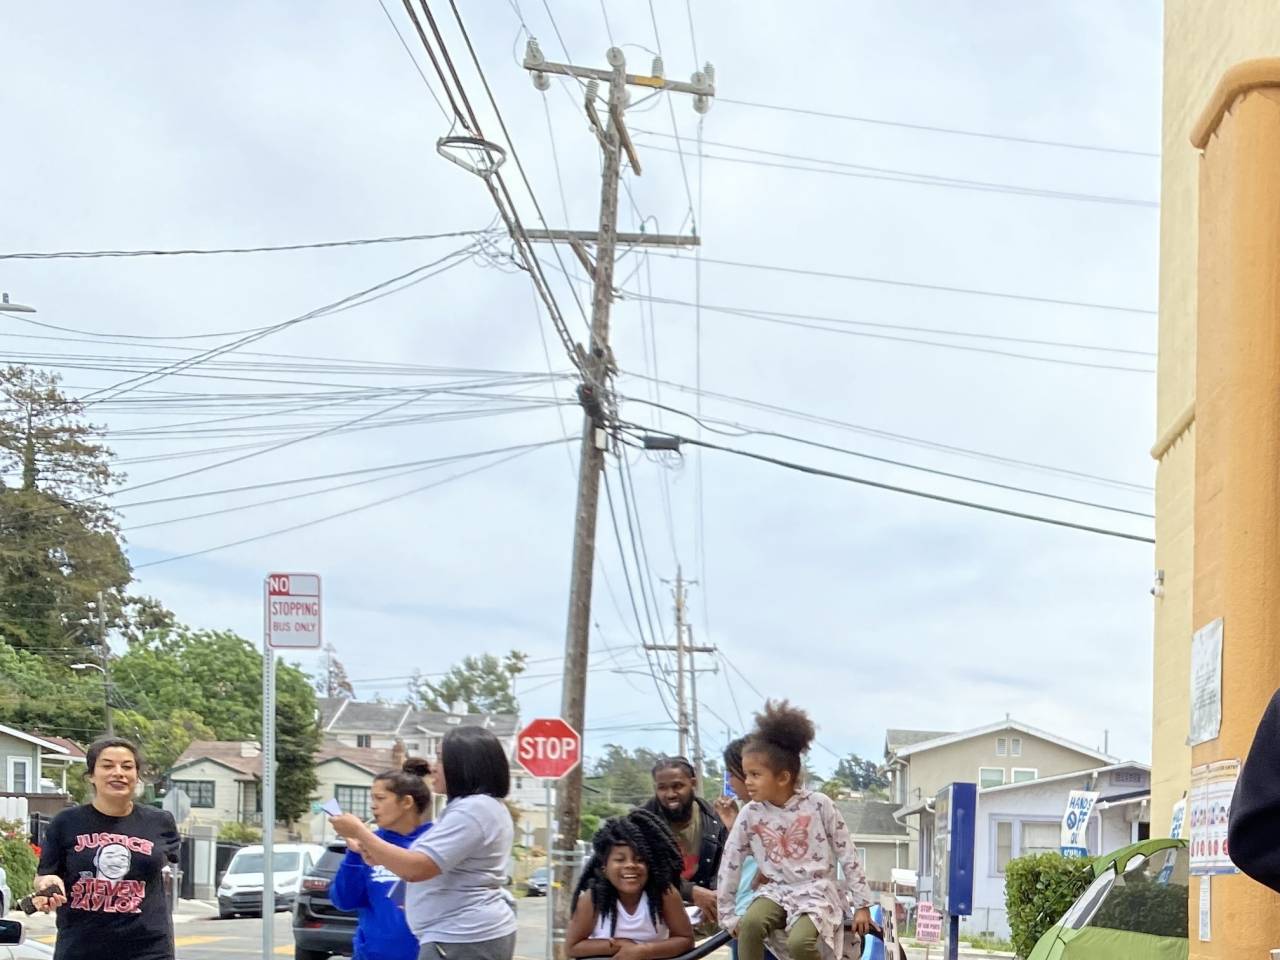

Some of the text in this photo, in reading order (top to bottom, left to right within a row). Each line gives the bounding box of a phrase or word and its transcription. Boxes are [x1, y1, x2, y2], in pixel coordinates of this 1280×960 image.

[269, 576, 289, 592] NO
[272, 601, 319, 616] STOPPING
[272, 621, 316, 632] BUS ONLY
[520, 736, 576, 760] STOP
[74, 832, 154, 856] JUSTICE
[71, 877, 147, 899] STEVEN
